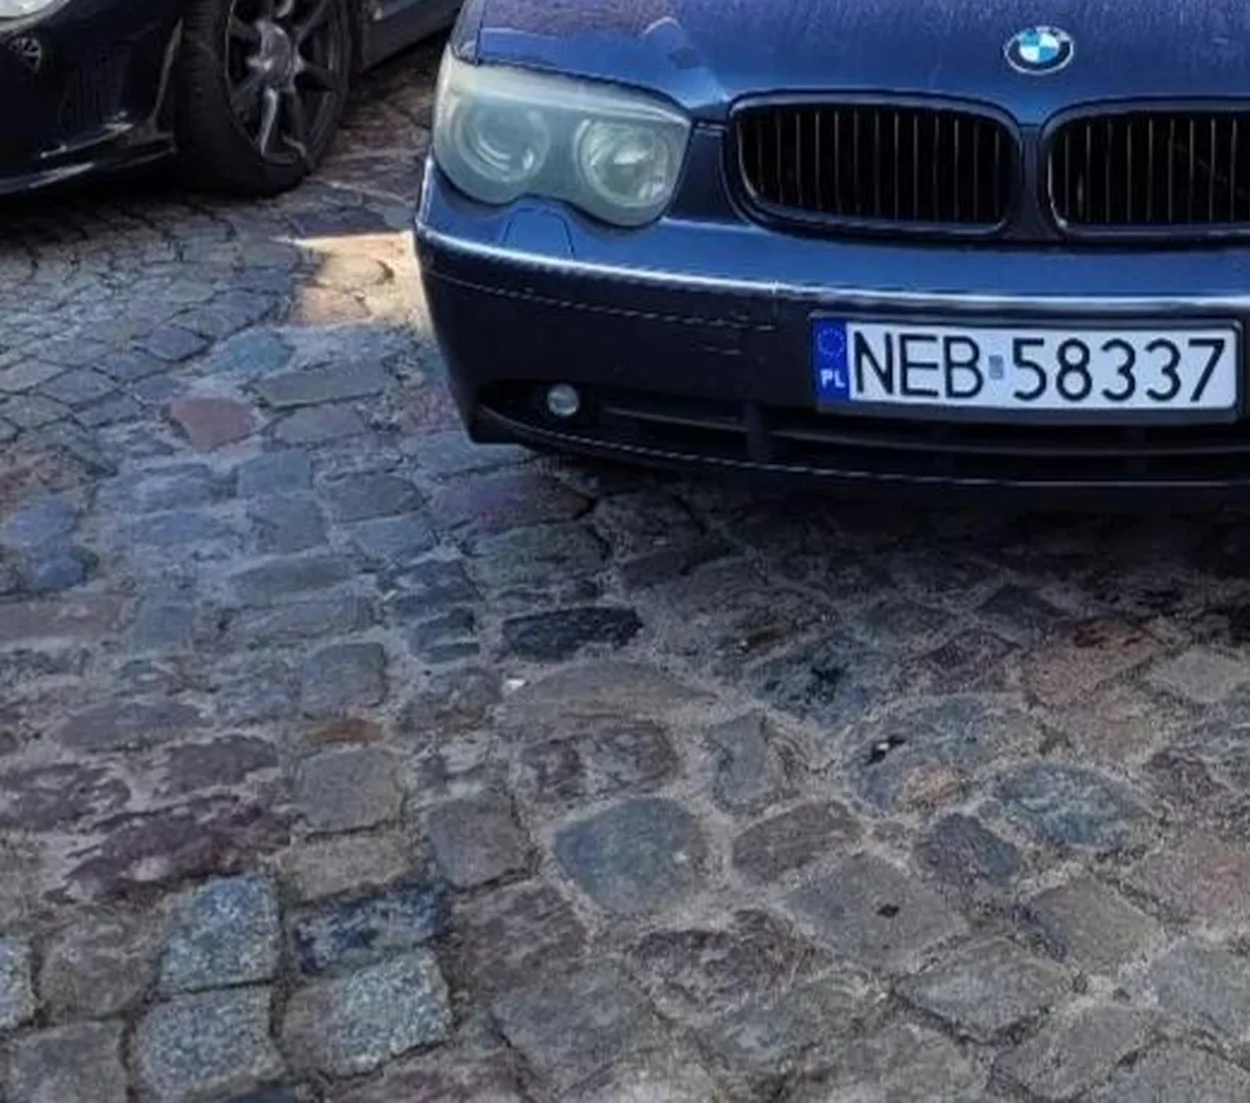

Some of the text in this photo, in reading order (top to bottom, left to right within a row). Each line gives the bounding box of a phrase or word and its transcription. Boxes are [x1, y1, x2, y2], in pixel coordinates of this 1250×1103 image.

[820, 369, 846, 388] PL
[853, 331, 1226, 402] NEB 58337
